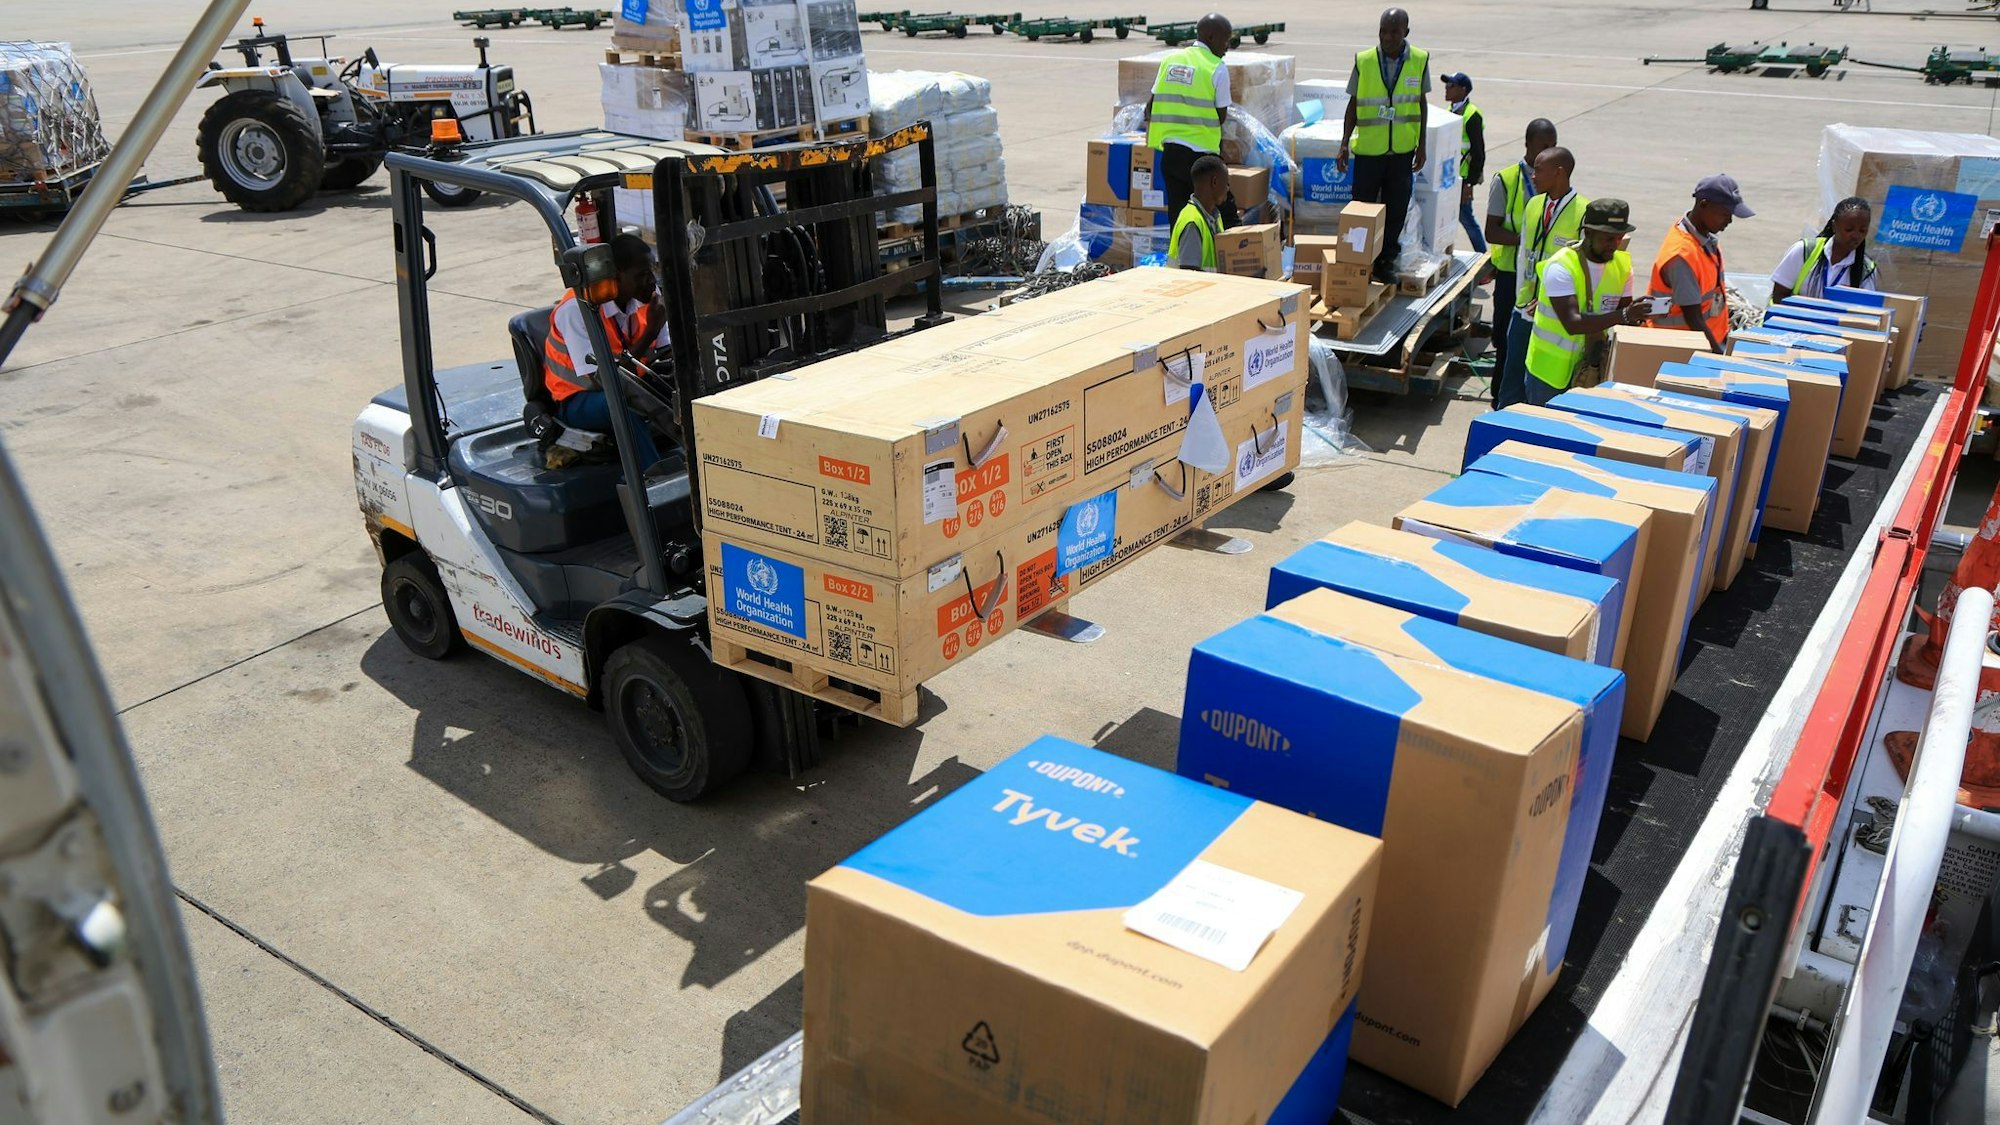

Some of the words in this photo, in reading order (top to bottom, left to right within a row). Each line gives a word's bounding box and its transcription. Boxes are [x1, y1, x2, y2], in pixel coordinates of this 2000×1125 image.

[694, 20, 720, 28] Organization
[1302, 92, 1325, 100] HANDLE
[1311, 184, 1332, 192] World
[1311, 192, 1353, 200] Organizatio
[1892, 219, 1920, 232] World
[1922, 224, 1954, 237] Health
[1888, 229, 1951, 247] Organization
[712, 332, 731, 383] OTA
[1264, 344, 1279, 358] World
[1280, 339, 1294, 353] Health
[1264, 350, 1294, 368] Organization
[1028, 400, 1070, 424] UN27162575
[1046, 434, 1066, 450] FIRST
[1086, 428, 1127, 455] S5088024
[1086, 453, 1105, 470] HIGH
[1106, 428, 1158, 460] PERFORMANCE
[1159, 420, 1176, 436] TENT
[702, 452, 742, 468] UN27162575
[1046, 447, 1062, 460] OPEN
[1046, 459, 1060, 470] THIS
[1060, 452, 1072, 464] BOX
[1256, 447, 1284, 468] Organization
[824, 460, 844, 476] Box
[847, 466, 866, 480] 1/2
[956, 474, 976, 497] OX
[982, 464, 1002, 485] 1/2
[708, 498, 744, 512] S5088024
[822, 498, 834, 507] 225
[991, 500, 1004, 514] 3/6
[710, 508, 725, 518] HIGH
[726, 511, 774, 530] PERFORMANCE
[774, 524, 792, 536] TENT
[796, 530, 806, 538] 24
[830, 510, 870, 524] ALPINTER
[969, 510, 982, 524] 2/6
[945, 520, 958, 535] 1/6
[1027, 518, 1062, 544] UN271625
[1066, 539, 1085, 556] World
[1086, 530, 1106, 548] Health
[1082, 562, 1100, 580] HIGH
[1101, 532, 1152, 568] PERFORMANCE
[1153, 523, 1170, 540] TENT
[1172, 516, 1181, 529] 24
[1064, 545, 1106, 568] Organization
[1020, 574, 1032, 586] OPEN
[1033, 568, 1044, 578] THIS
[1044, 562, 1054, 571] BOX
[1027, 562, 1036, 572] NOT
[828, 578, 848, 594] Box
[850, 584, 868, 599] 2/2
[1020, 578, 1038, 593] BEFORE
[1020, 586, 1040, 602] OPENING
[736, 587, 762, 604] World
[764, 596, 793, 617] Health
[1020, 605, 1030, 614] Box
[736, 600, 794, 629] Organization
[826, 613, 838, 622] 225
[472, 602, 562, 660] tradewinds
[716, 618, 732, 626] HIGH
[733, 622, 780, 640] PERFORMANCE
[780, 635, 798, 646] TENT
[834, 624, 874, 640] ALPINTER
[989, 618, 1002, 632] 6/6
[968, 630, 980, 644] 5/6
[944, 643, 958, 656] 4/6
[1211, 709, 1282, 752] DUPONT
[1035, 761, 1118, 795] DUPONT
[1532, 773, 1568, 817] DUPONT
[992, 788, 1140, 856] Tyvek
[1946, 846, 1976, 859] ROLLER
[1957, 856, 1972, 864] NOT
[1968, 844, 2000, 860] CAUT
[1962, 864, 1994, 877] COMBIN
[1342, 907, 1361, 992] DUPONT
[1066, 940, 1184, 990] dpp.dupont.com
[1354, 1011, 1421, 1048] dupont.com
